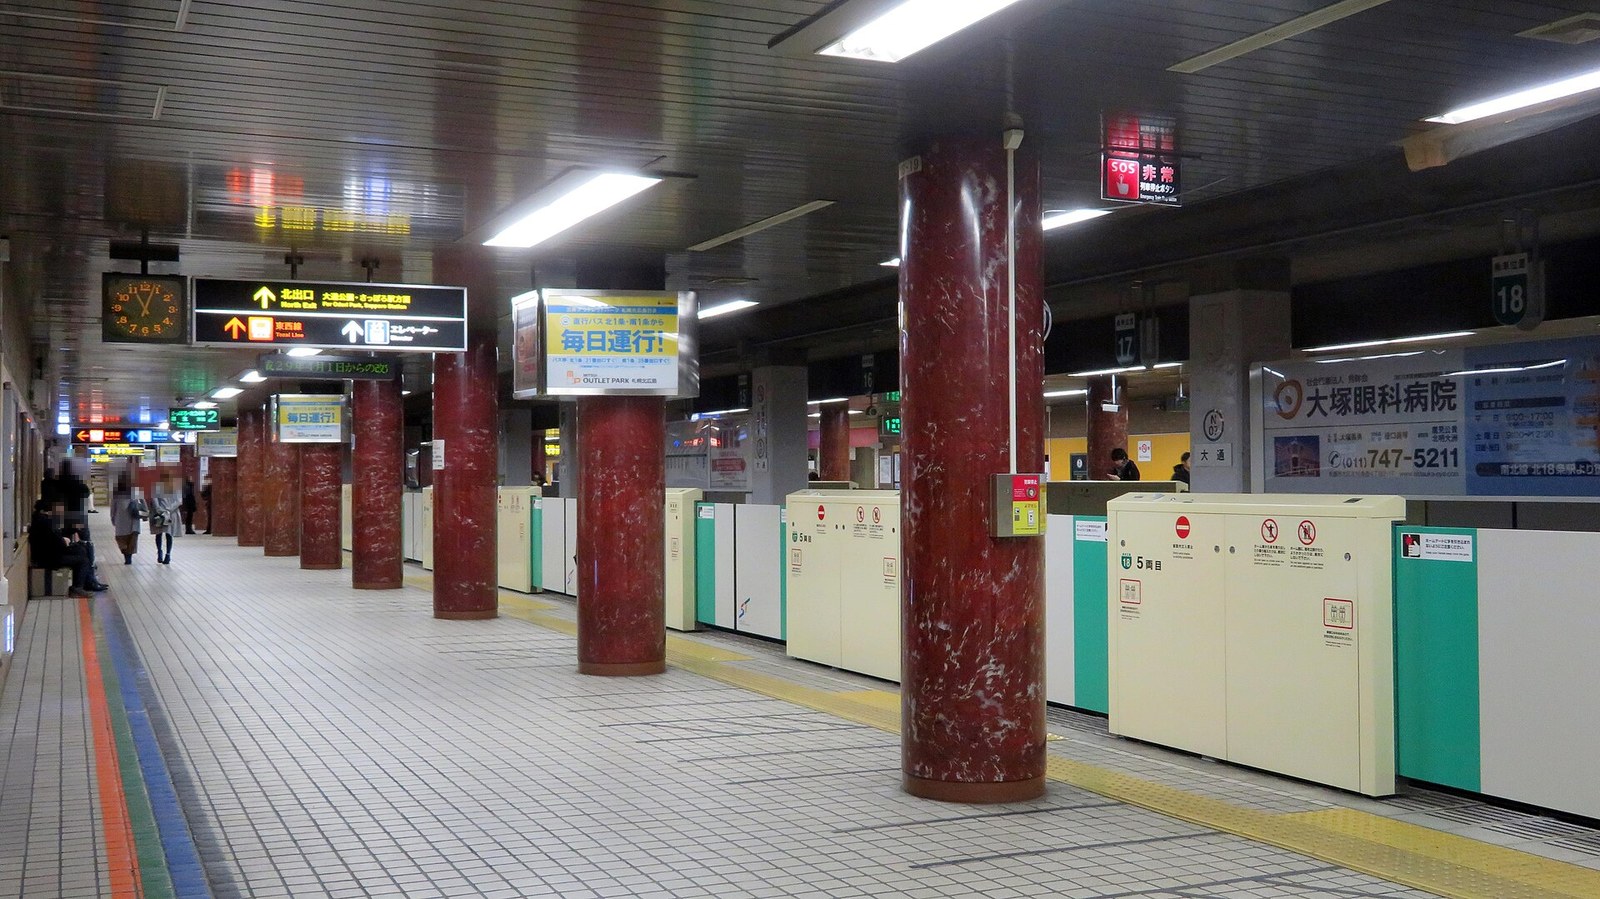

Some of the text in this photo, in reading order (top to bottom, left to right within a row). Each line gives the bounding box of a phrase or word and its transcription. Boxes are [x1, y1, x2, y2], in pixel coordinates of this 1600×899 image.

[1111, 161, 1135, 174] SOS
[1142, 164, 1174, 183] 非常
[1140, 181, 1175, 193] 列車停止ボタン
[129, 286, 137, 294] 11
[280, 289, 314, 301] 北出口
[117, 294, 129, 302] 10
[163, 294, 171, 302] 2
[1497, 284, 1523, 314] 18
[114, 304, 122, 312] 9
[168, 305, 176, 313] 3
[120, 316, 128, 324] 8
[163, 317, 170, 325] 4
[275, 321, 303, 331] 東西線
[141, 326, 149, 334] 6
[390, 325, 438, 335] エレベーター
[561, 329, 663, 353] 毎日運行!
[1118, 336, 1133, 356] 17
[864, 372, 873, 388] 16
[1306, 379, 1457, 418] 大塚眼科病院
[207, 410, 218, 423] 2
[1200, 449, 1225, 461] 大通
[1122, 558, 1131, 568] 18
[1136, 556, 1162, 571] 5両目
